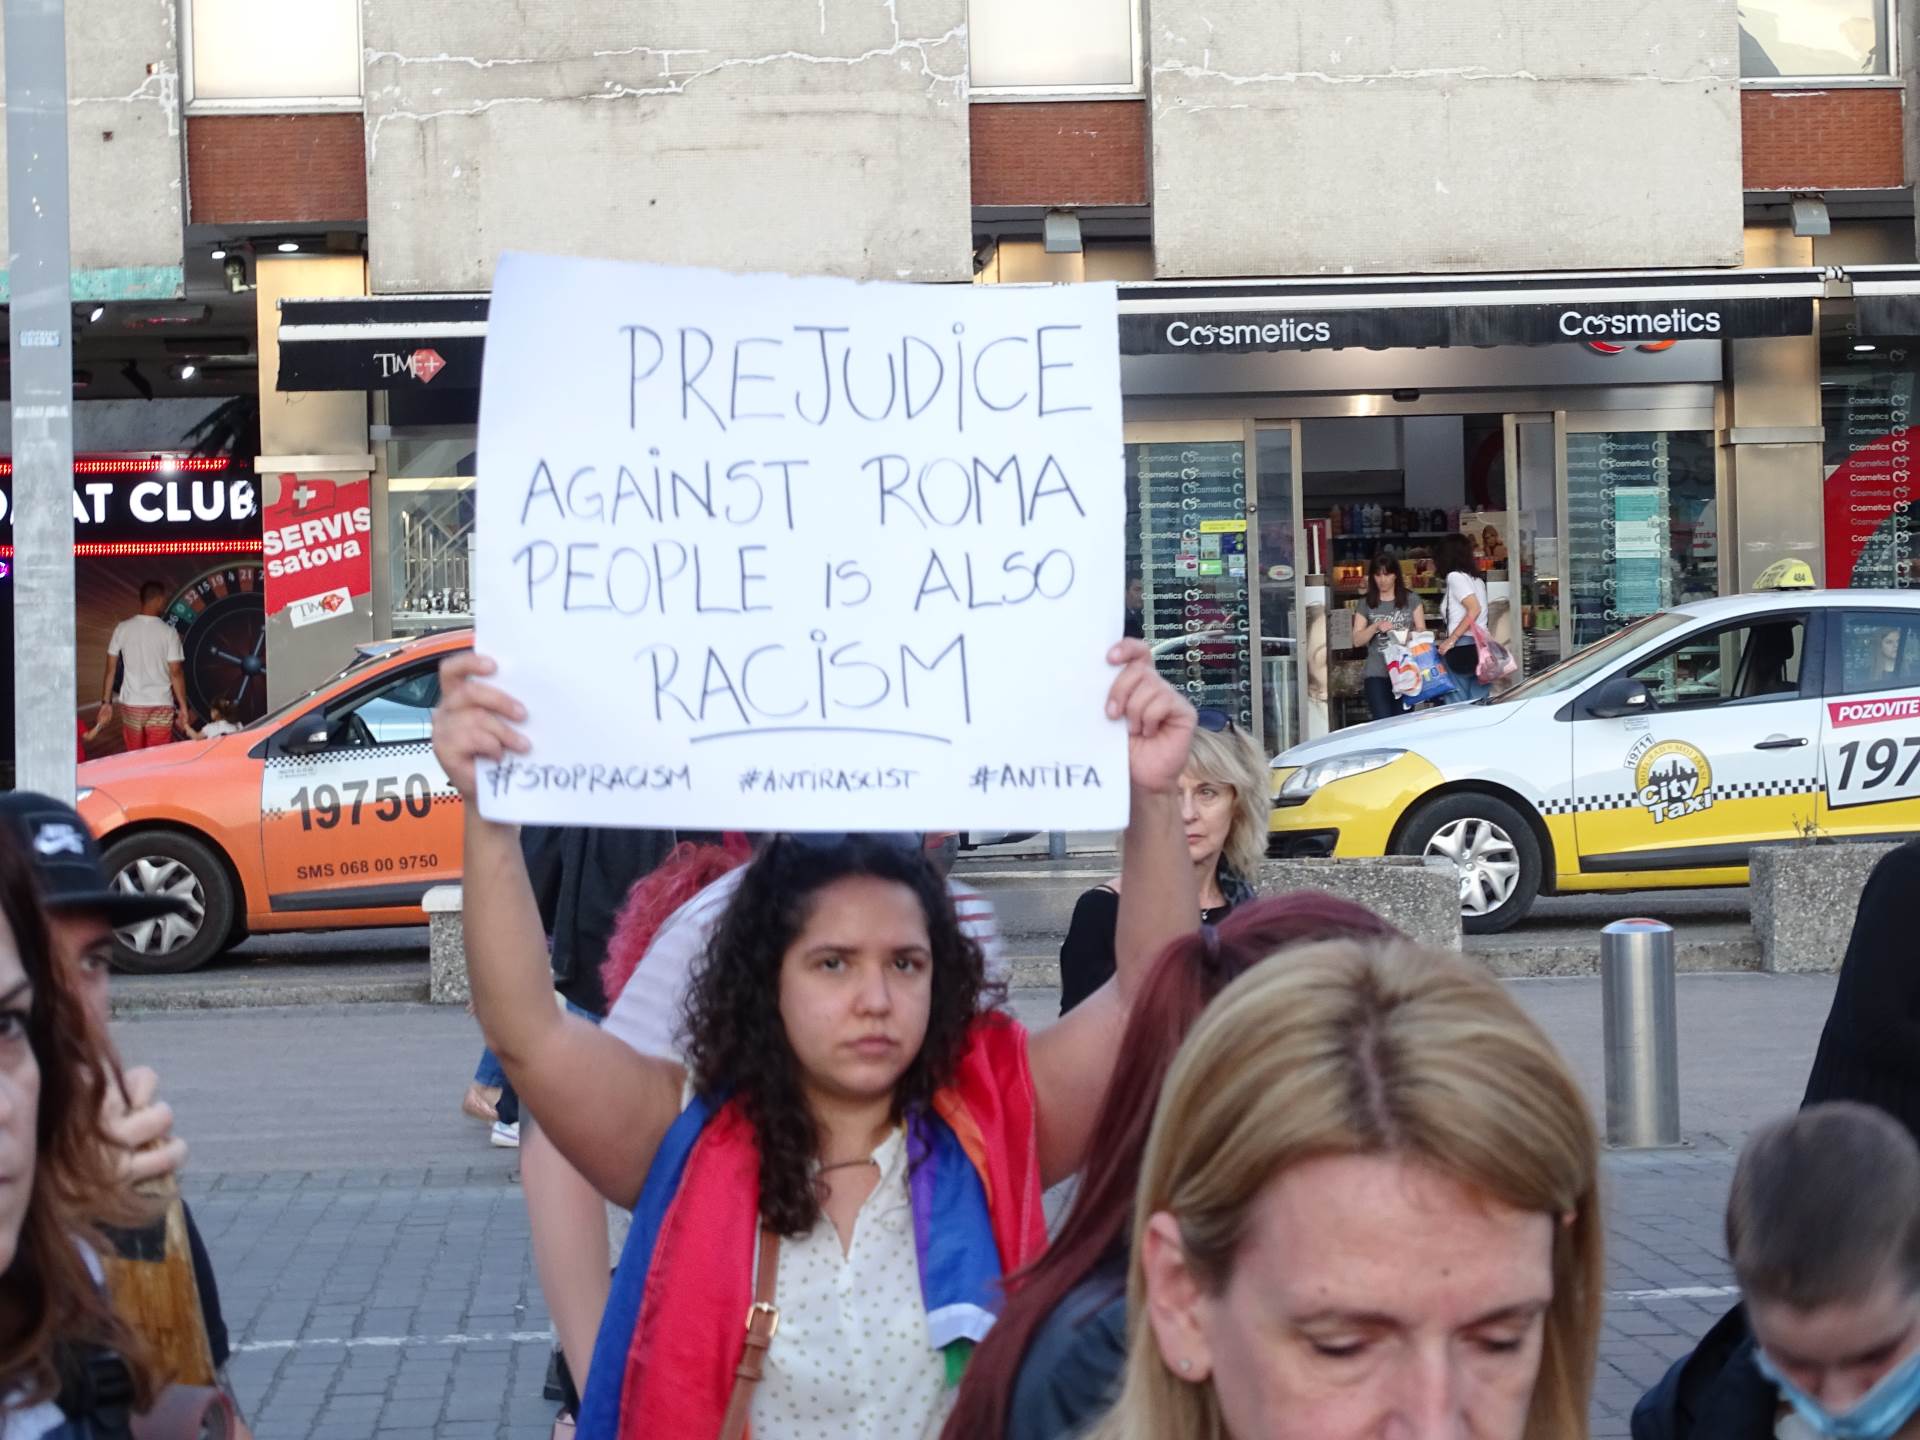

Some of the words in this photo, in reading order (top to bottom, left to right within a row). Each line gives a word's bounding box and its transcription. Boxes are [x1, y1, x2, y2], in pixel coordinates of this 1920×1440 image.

[1166, 318, 1330, 346] Cosmetics
[1559, 308, 1721, 336] Cosmetics
[129, 480, 255, 523] CLUB
[861, 454, 1086, 529] ROMA
[264, 507, 370, 556] SERVIS
[240, 568, 252, 580] 21
[267, 540, 361, 577] satova
[512, 539, 773, 615] PEOPLE
[914, 548, 1076, 611] ALSO
[1838, 699, 1920, 722] POZOVITE
[1627, 736, 1654, 767] 19711
[290, 772, 432, 832] 19750
[1640, 777, 1698, 807] City
[1649, 788, 1713, 824] Taxi
[297, 863, 334, 880] SMS
[340, 860, 369, 875] 068
[375, 857, 393, 873] 00
[399, 854, 438, 870] 9750
